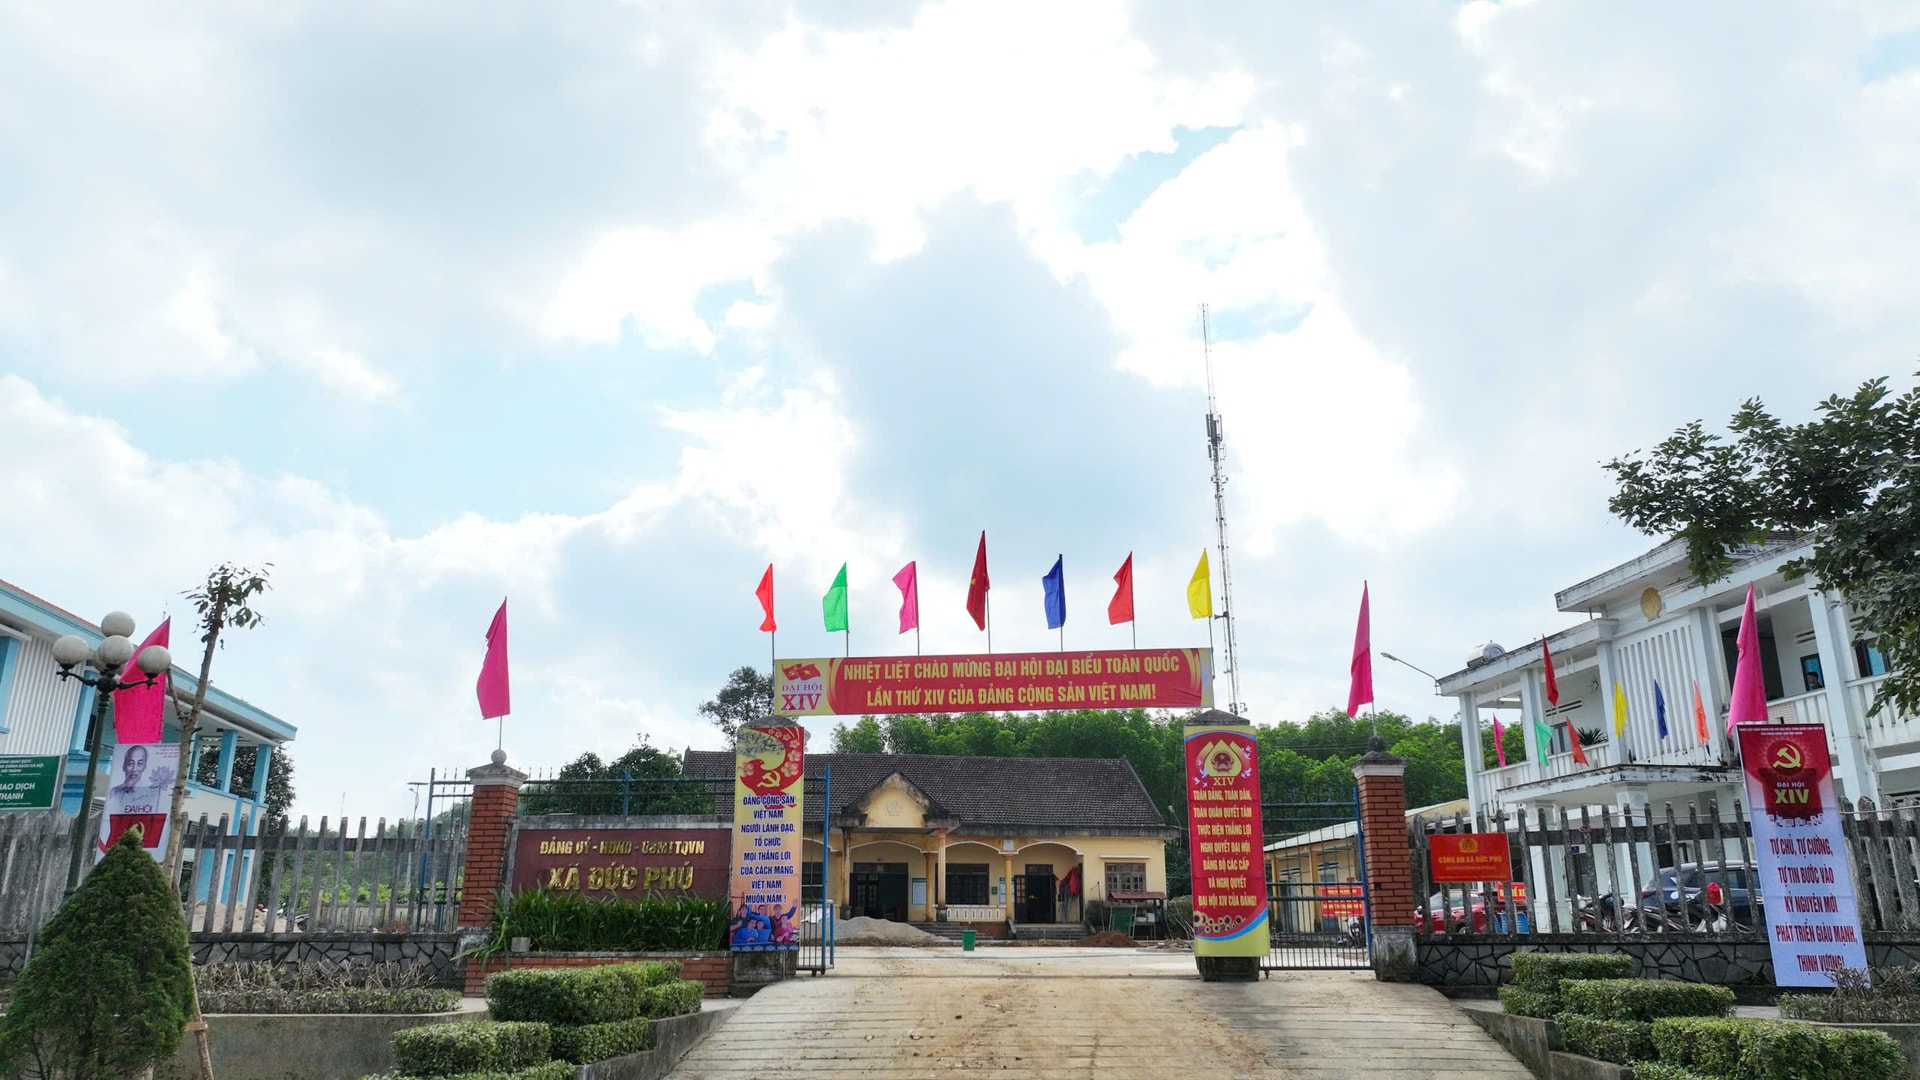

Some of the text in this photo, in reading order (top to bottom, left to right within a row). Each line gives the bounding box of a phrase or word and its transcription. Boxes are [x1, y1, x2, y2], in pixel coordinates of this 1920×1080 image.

[844, 650, 1180, 683] NHIỆT LIỆT CHÀO MỪNG ĐẠI HỘI ĐẠI BIỂU TOÀN QUỐC
[782, 682, 822, 692] ĐẠI HỘI
[866, 681, 1156, 706] LẦN THỨ XIV CỦA ĐẢNG CỘNG SẢN VIỆT NAM!
[780, 693, 822, 711] XIV
[15, 782, 36, 791] DỊCH
[1212, 777, 1235, 786] XIV
[743, 794, 795, 806] ĐẢNG CỘNG SẢN
[1774, 789, 1809, 804] XIV
[754, 810, 784, 820] VIỆT NAM
[540, 836, 572, 855] ĐẢNG
[755, 835, 781, 846] TỔ CHỨC
[1770, 833, 1834, 858] TỰ CHỦ, TỰ CƯỜNG,
[744, 850, 791, 863] MỌI THẮNG LỢI
[1439, 855, 1455, 864] CÔNG
[1466, 855, 1474, 863] XÃ
[546, 861, 694, 890] XÃ ĐỨC PHÚ
[740, 864, 793, 876] CỦA CÁCH MẠNG
[1778, 864, 1835, 887] TỰ TIN BƯỚC VÀO
[751, 880, 782, 891] VIỆT NAM
[746, 894, 765, 904] MUÔN
[767, 894, 782, 903] NĂM
[1784, 891, 1838, 912] KỶ NGUYÊN MỚI
[1775, 918, 1858, 946] PHÁT TRIỂN GIÀU MẠNH,
[1797, 955, 1818, 976] THỊNH
